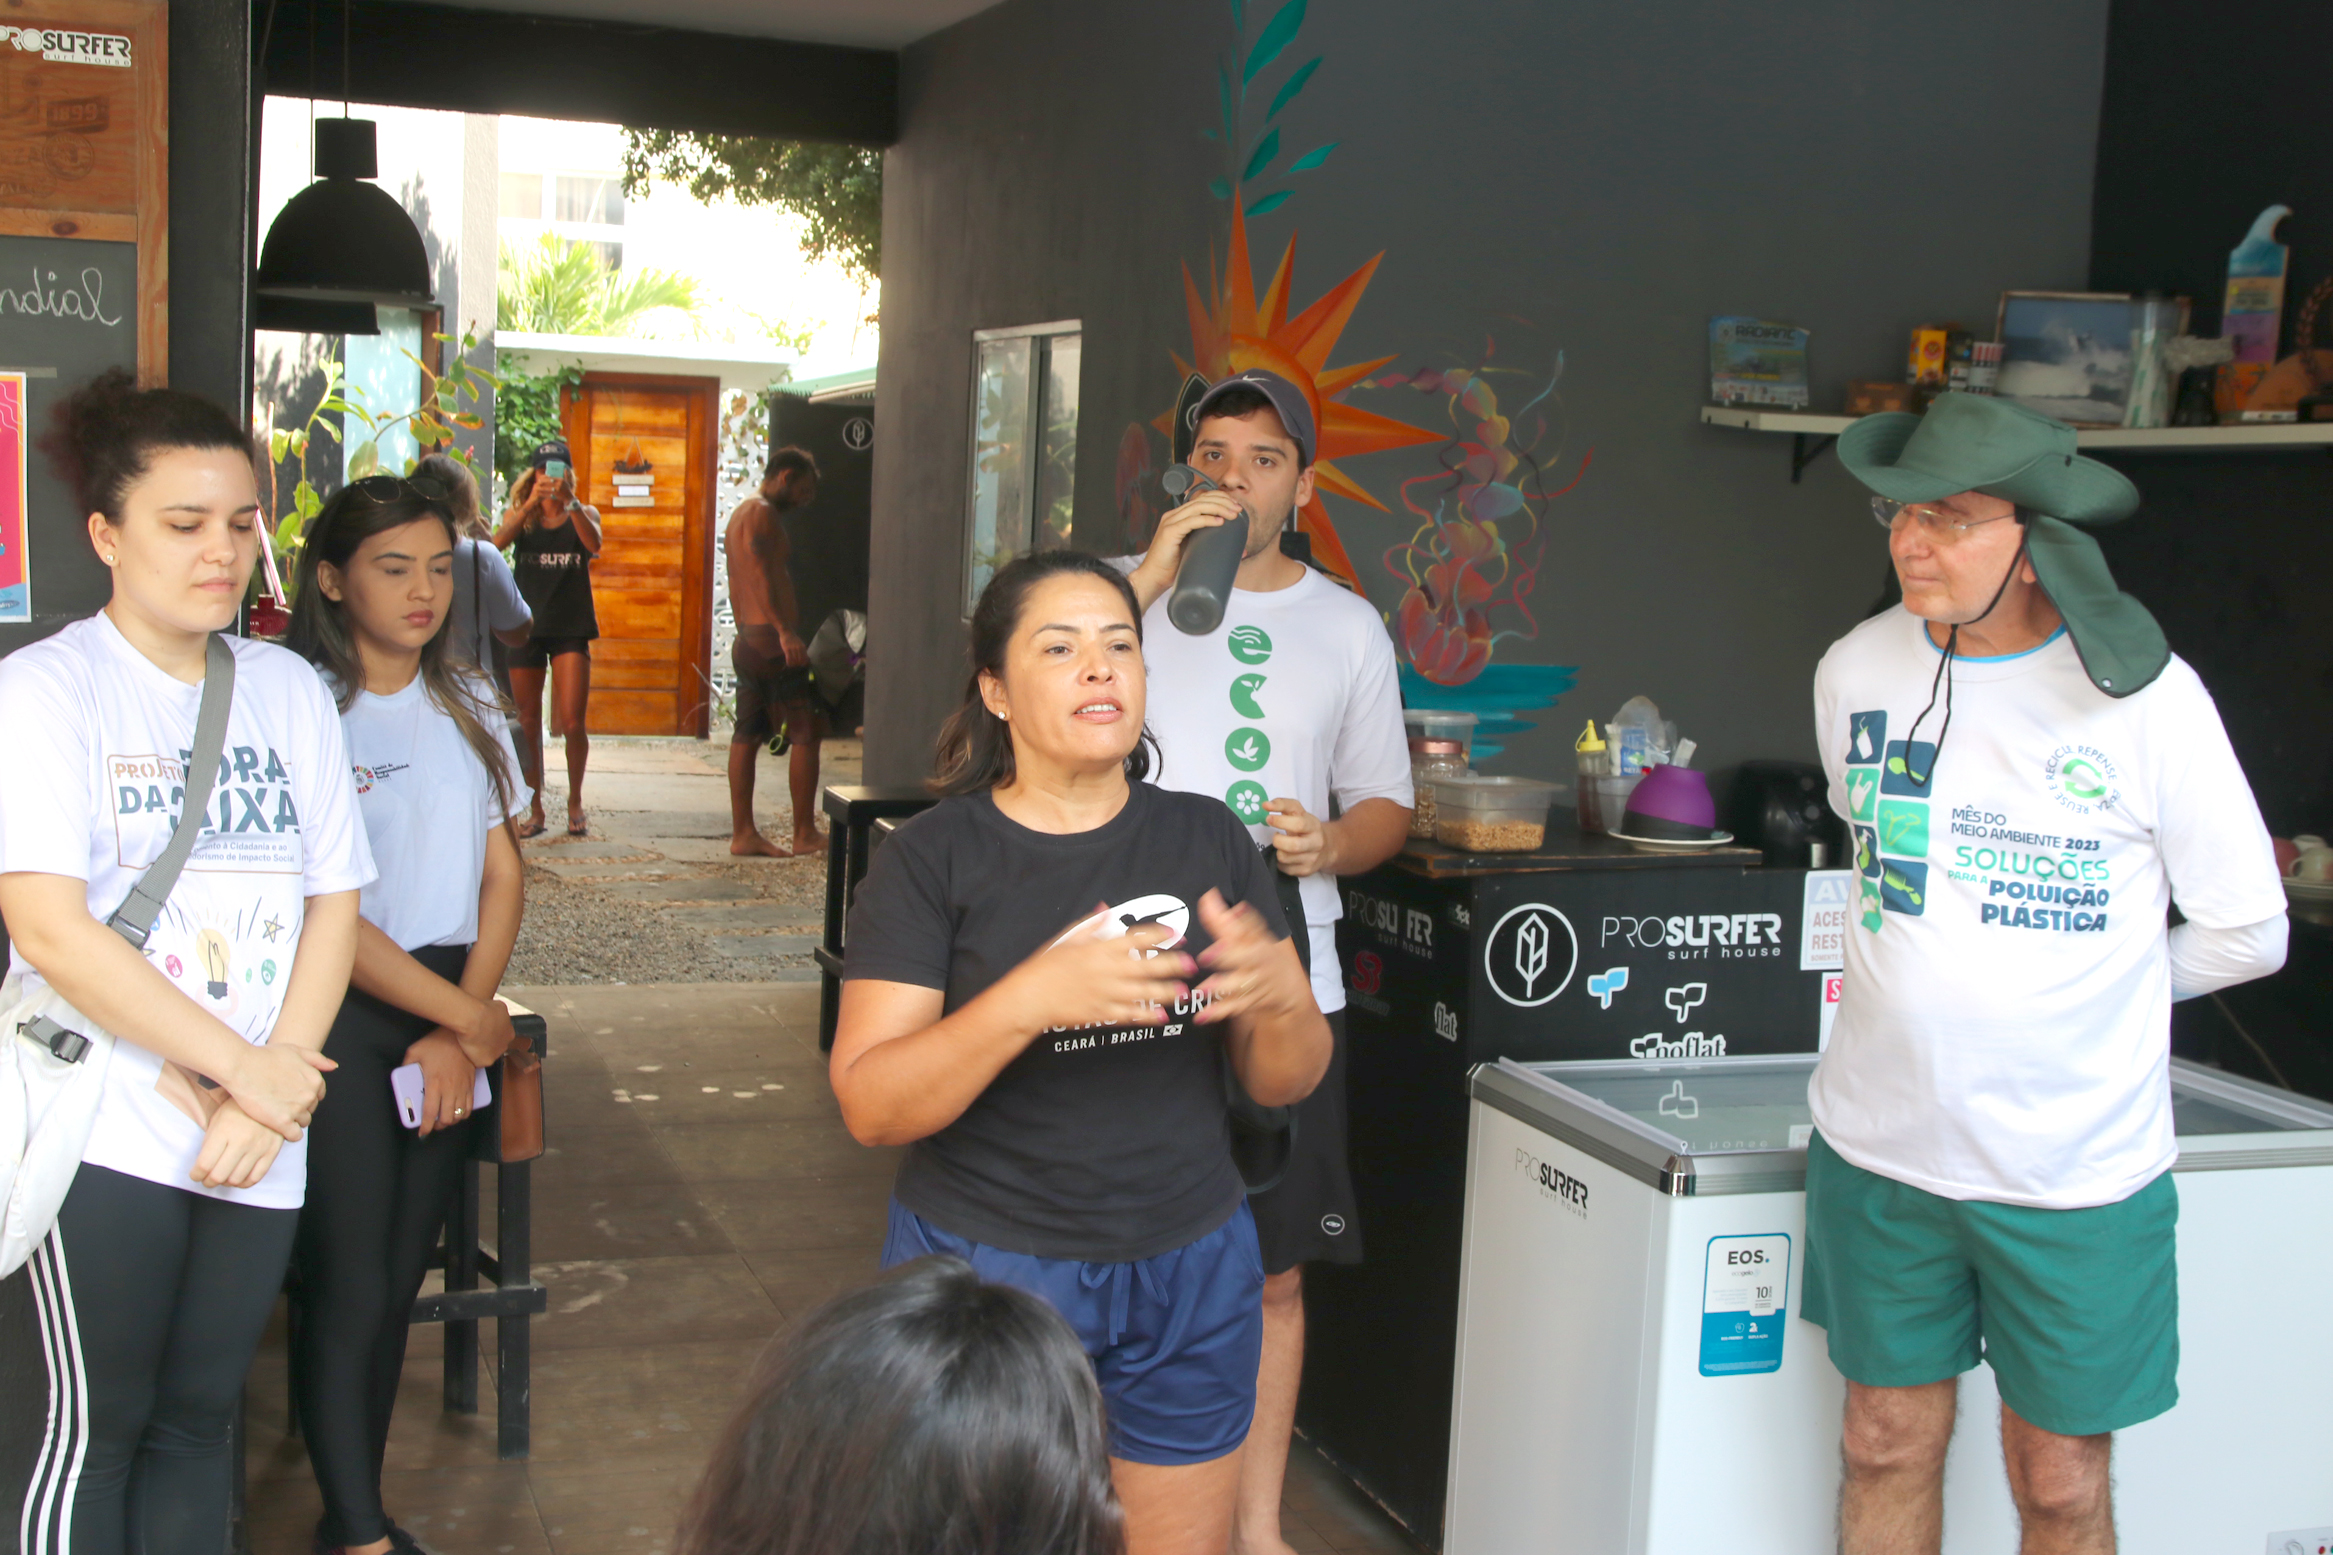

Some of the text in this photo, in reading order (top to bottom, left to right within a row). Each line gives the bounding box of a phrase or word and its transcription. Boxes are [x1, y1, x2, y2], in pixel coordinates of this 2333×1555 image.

[44, 52, 130, 66] surf house
[0, 266, 122, 326] ndial
[118, 785, 168, 814] DA
[1952, 804, 2006, 826] MÊS DO
[230, 842, 270, 850] Cidadania
[1951, 823, 2101, 851] MEIO AMBIENTE 2023
[226, 853, 236, 861] de
[239, 853, 272, 863] Impacto
[273, 854, 295, 863] Social
[1955, 845, 2110, 882] SOLUÇÕES
[1948, 870, 1988, 884] PARA A
[1989, 880, 2109, 908] POLUIÇÃO
[1813, 911, 1847, 928] ACES
[1981, 901, 2107, 931] PLÁSTICA
[1601, 913, 1782, 948] PROSURFER
[1812, 933, 1844, 950] REST
[1667, 946, 1781, 960] surf house
[1054, 1027, 1155, 1053] CEARÁ BRASIL
[1515, 1147, 1588, 1210] PROSURFER
[1561, 1198, 1588, 1220] house
[1756, 1286, 1769, 1299] 10
